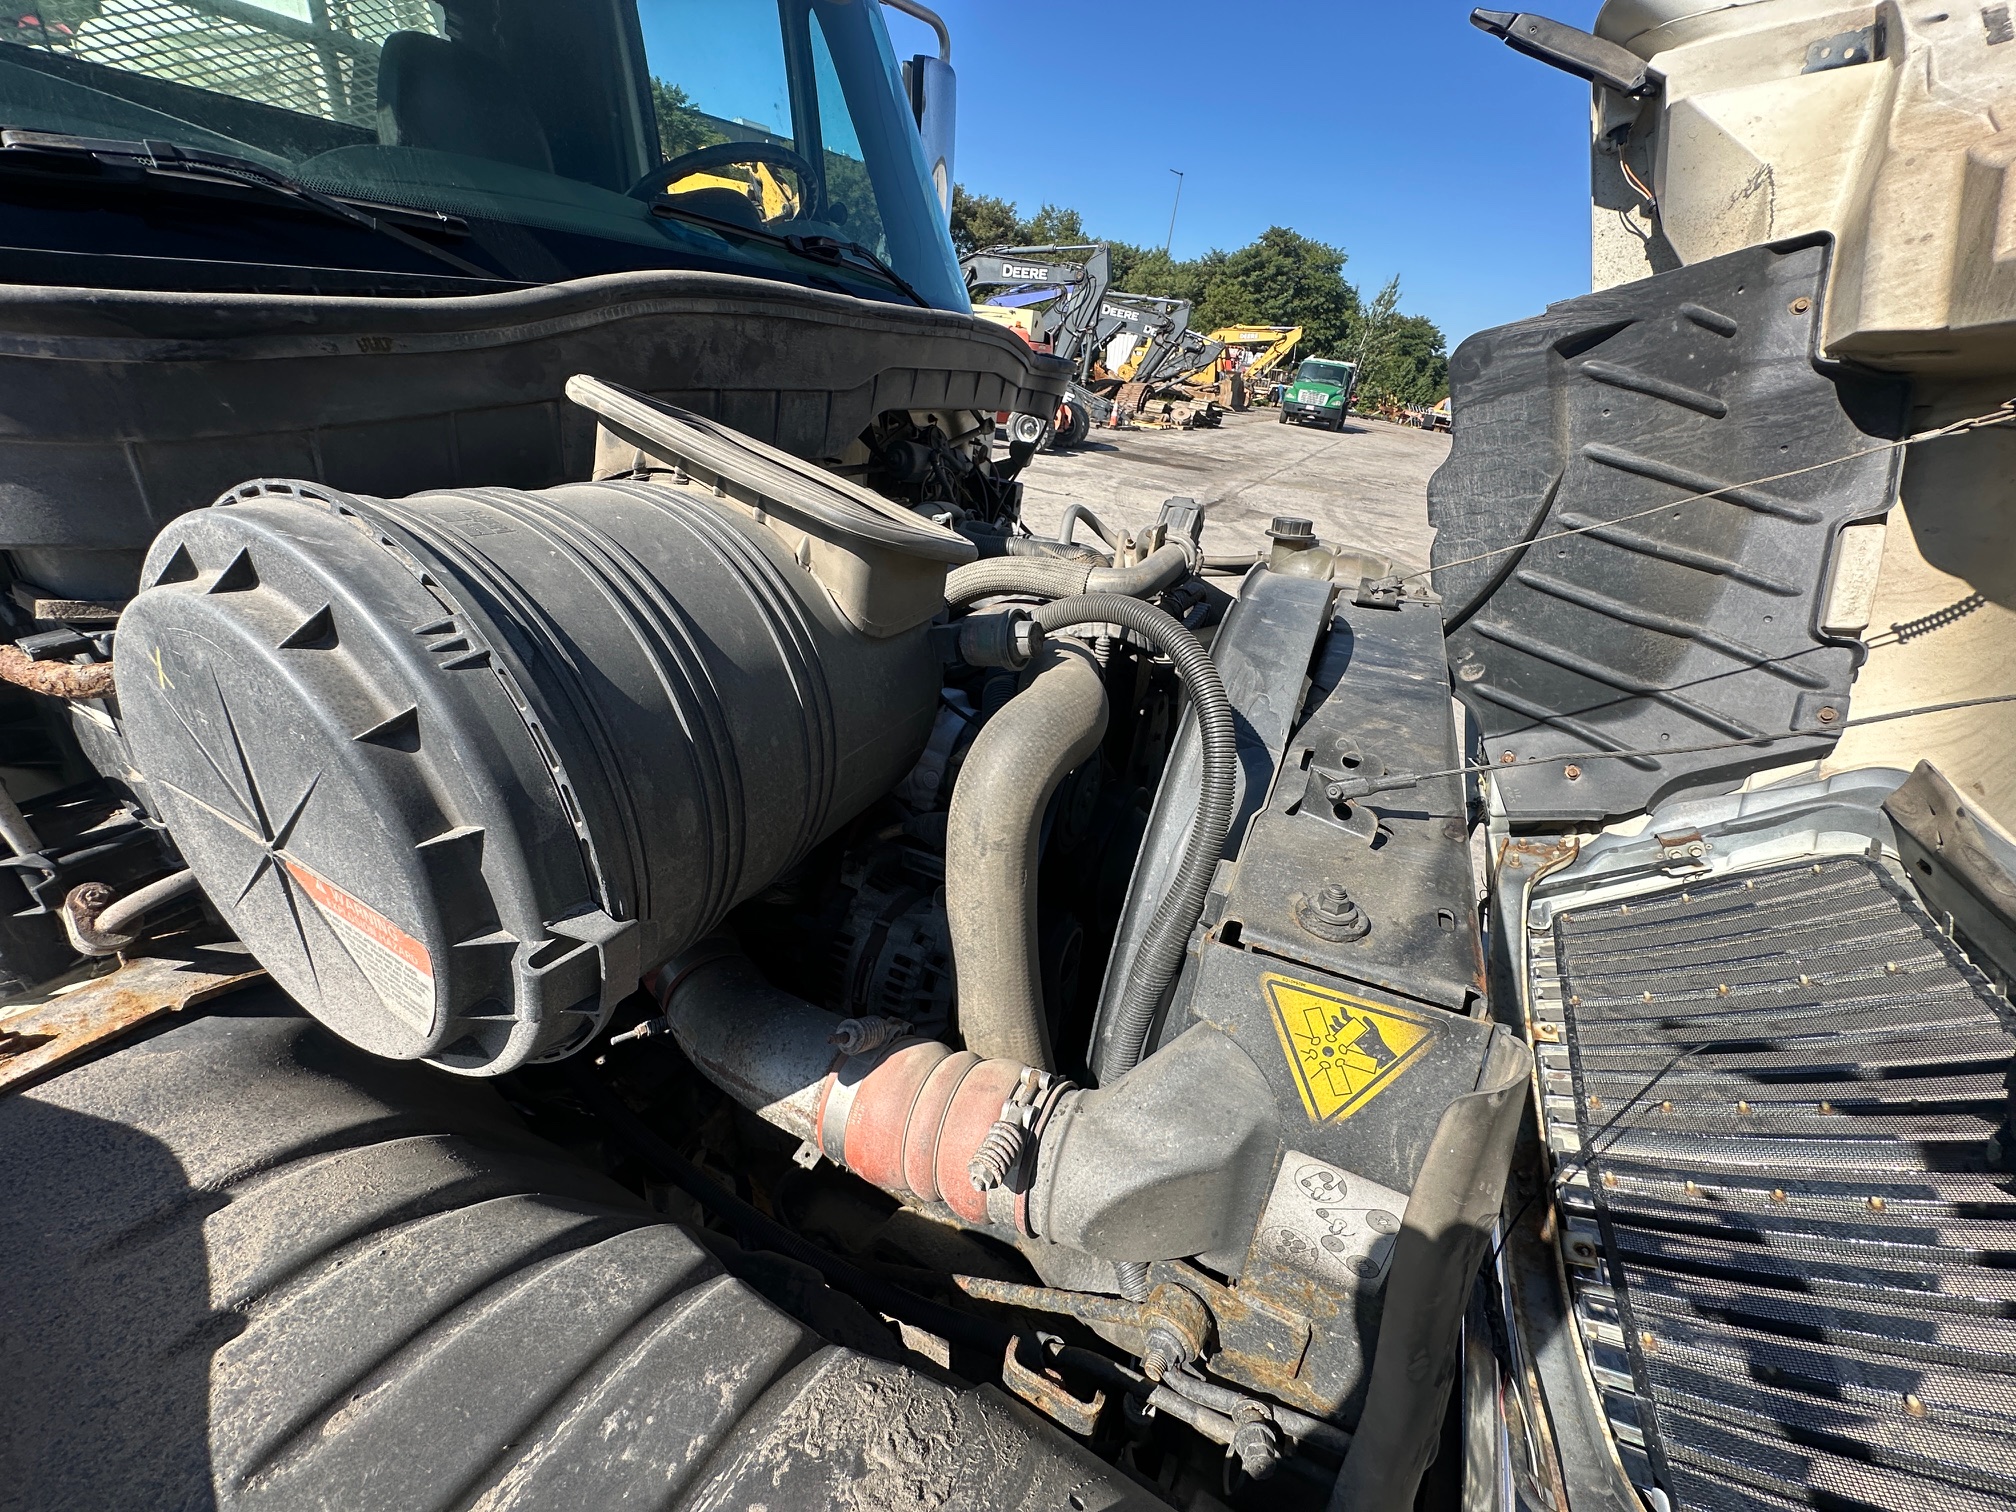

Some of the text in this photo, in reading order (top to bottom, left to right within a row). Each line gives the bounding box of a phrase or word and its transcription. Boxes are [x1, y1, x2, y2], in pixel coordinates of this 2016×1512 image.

[1002, 263, 1048, 280] DEERE
[1101, 303, 1140, 321] DEERE
[326, 898, 419, 965] EXPLOSION HAZARD
[329, 887, 399, 941] WARNING
